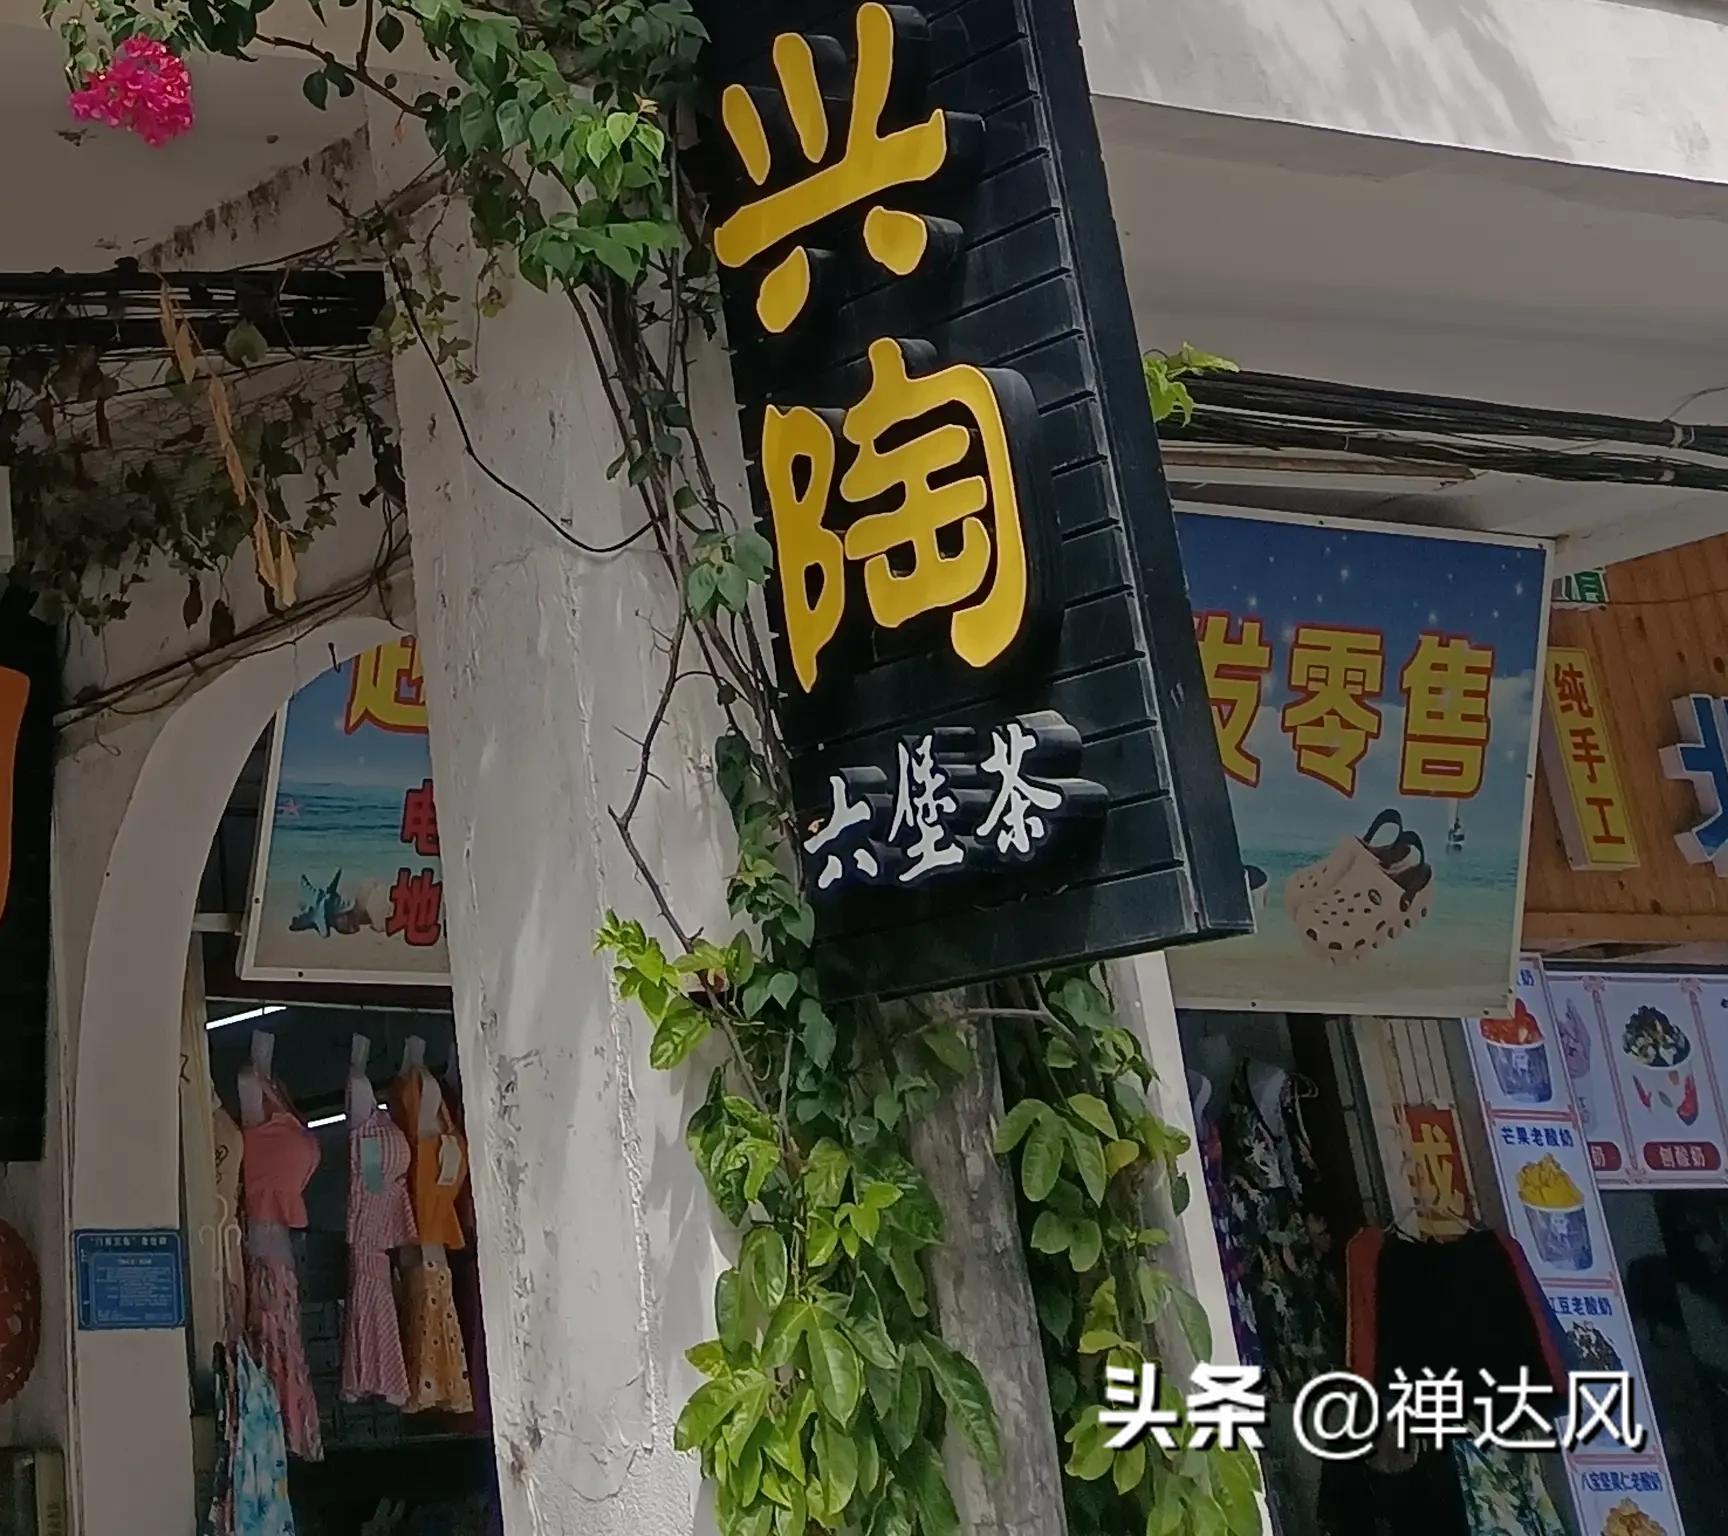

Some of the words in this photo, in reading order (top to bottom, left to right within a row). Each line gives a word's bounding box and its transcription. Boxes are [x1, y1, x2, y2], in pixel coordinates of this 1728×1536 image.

[803, 723, 1062, 889] 六堡茶
[1554, 663, 1625, 845] 纯手工
[1502, 1127, 1573, 1147] 芒果老酸奶
